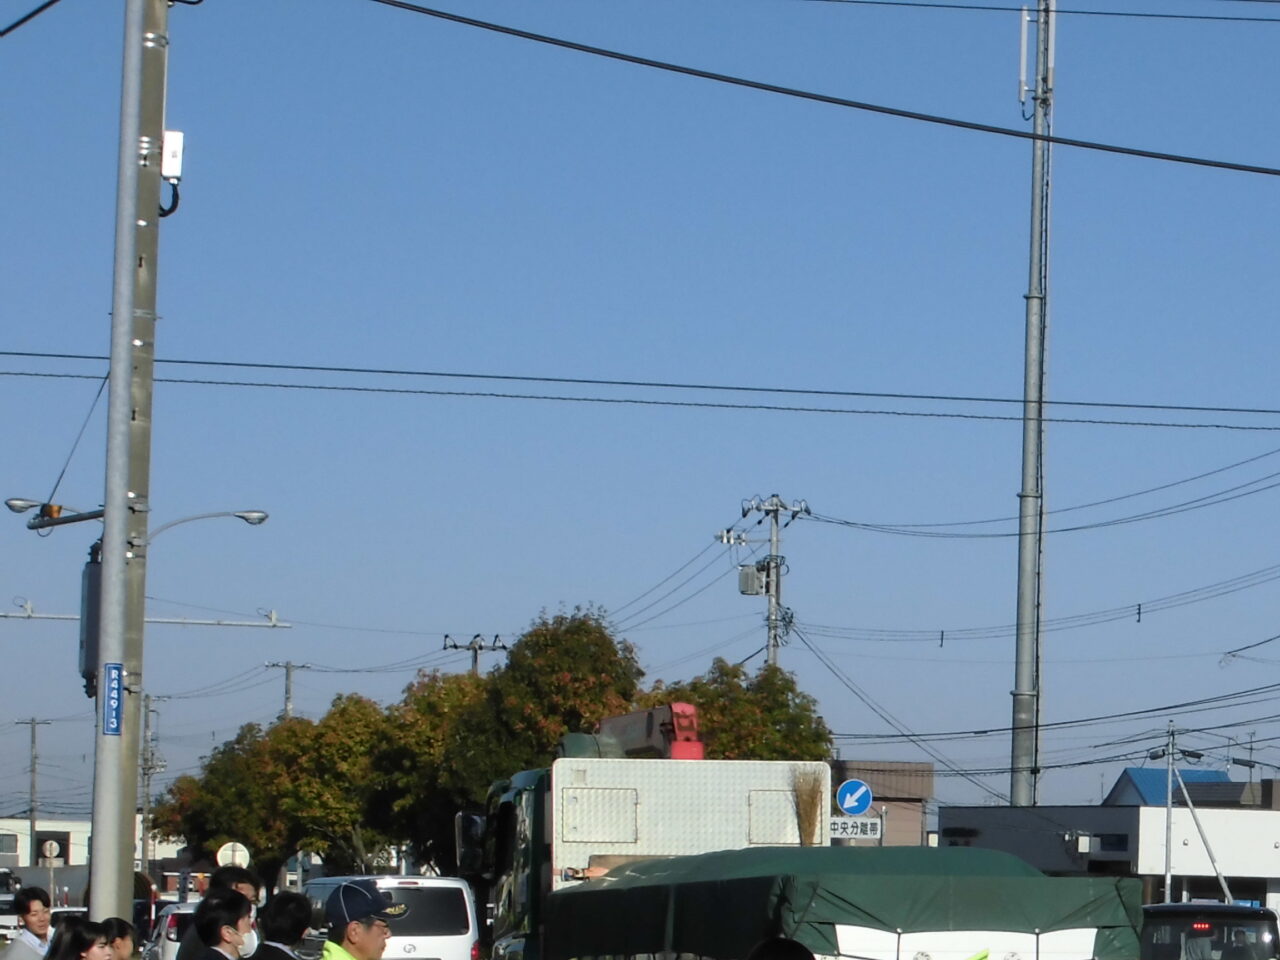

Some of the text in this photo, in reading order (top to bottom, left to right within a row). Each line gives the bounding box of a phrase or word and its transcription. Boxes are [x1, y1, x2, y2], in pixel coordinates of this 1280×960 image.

[830, 821, 878, 835] 中央分離帯
